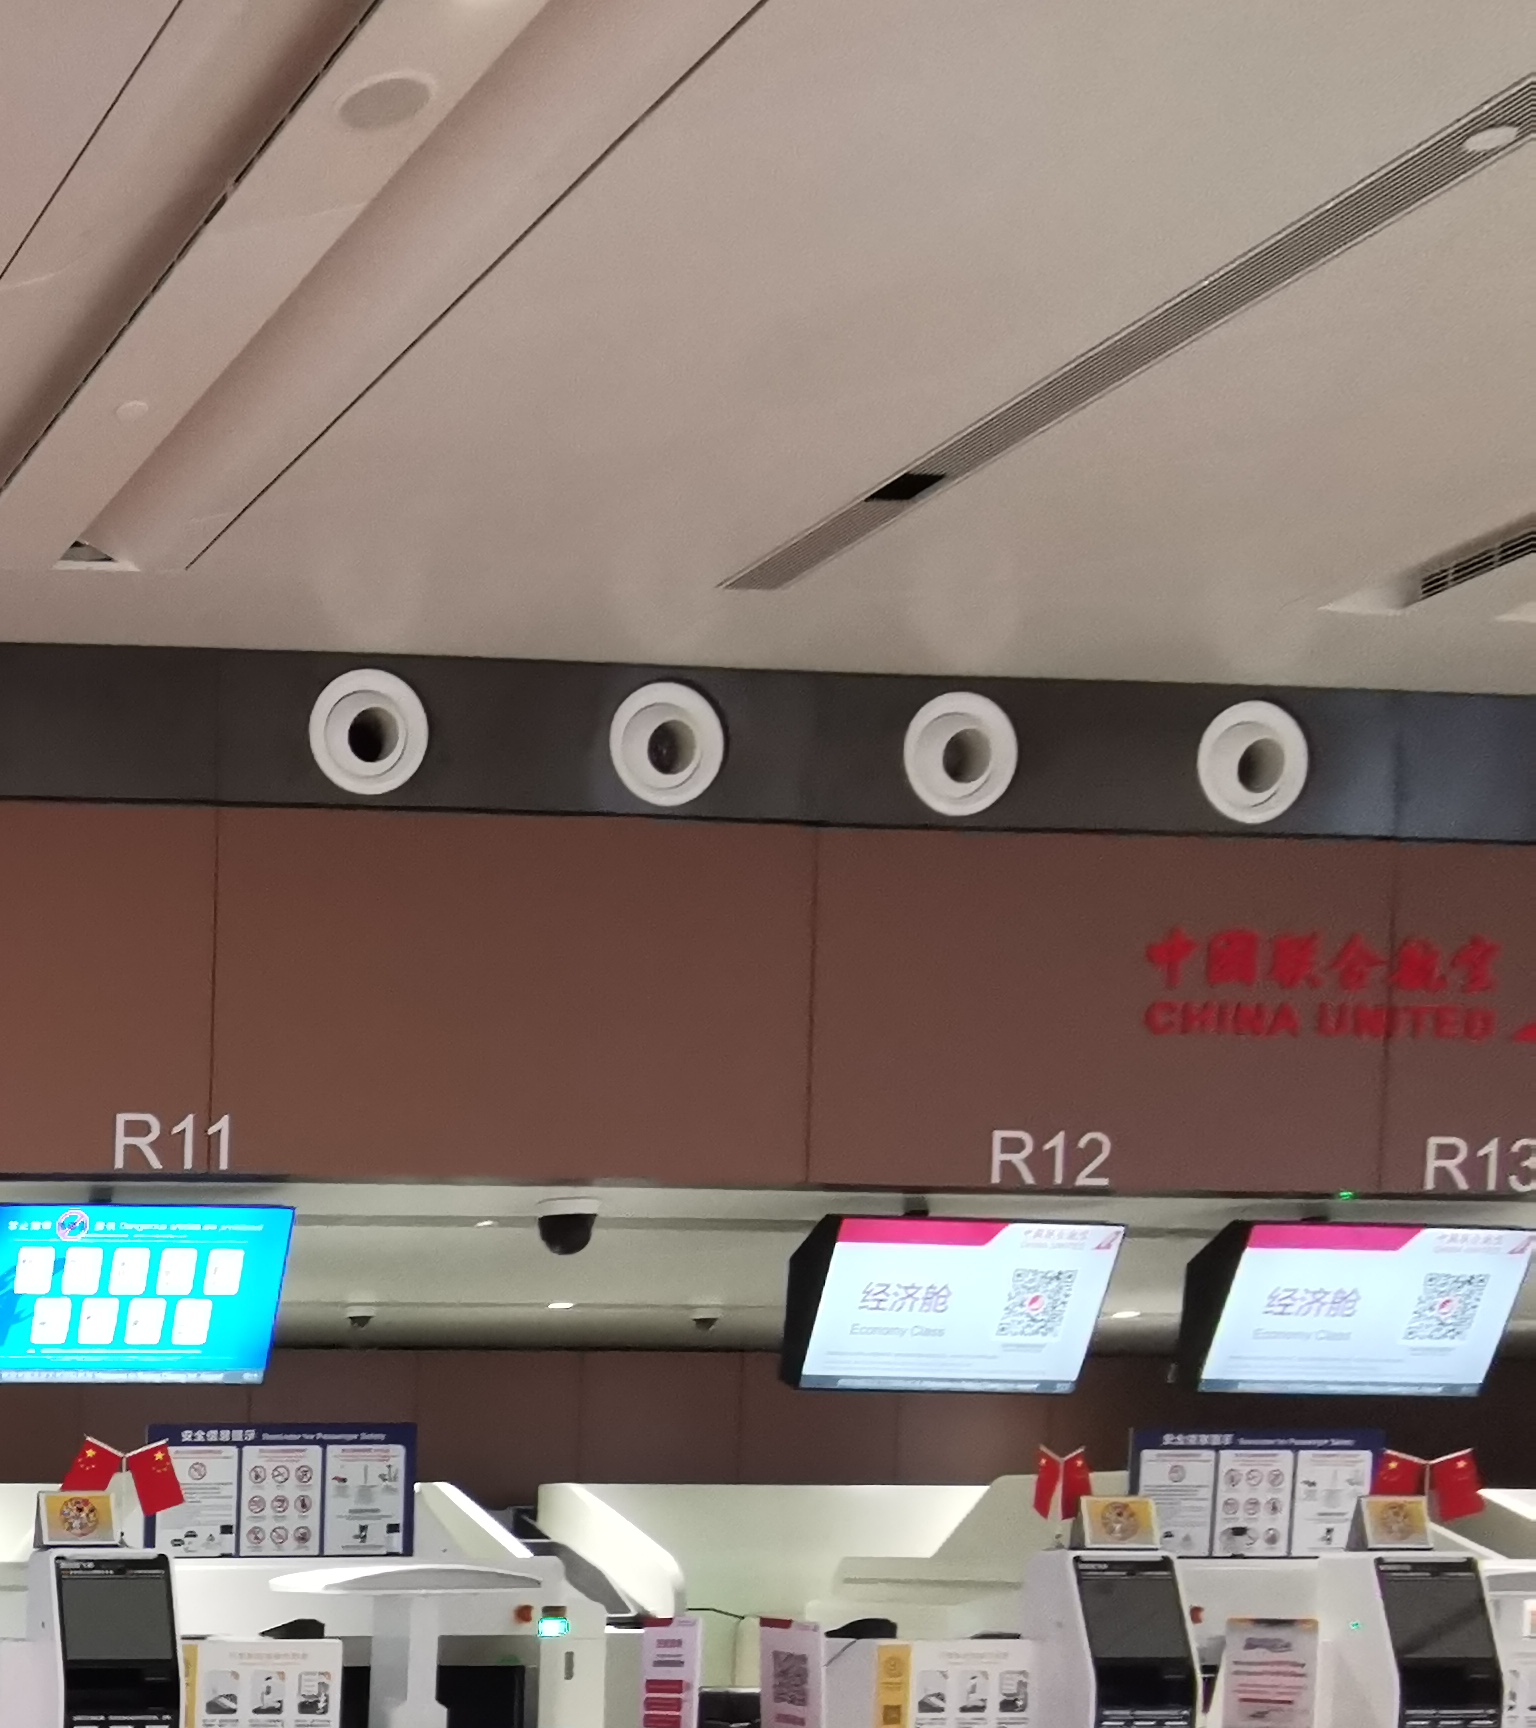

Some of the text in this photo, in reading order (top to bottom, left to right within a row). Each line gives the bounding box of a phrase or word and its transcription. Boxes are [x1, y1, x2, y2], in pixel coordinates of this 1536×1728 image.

[1143, 1000, 1498, 1041] CHINA UNITED
[114, 1112, 230, 1171] R11
[990, 1130, 1113, 1187] R12
[1423, 1136, 1536, 1191] R13
[858, 1281, 953, 1314] 经济舱
[1262, 1287, 1362, 1318] 经济舱
[849, 1323, 946, 1338] Economy Class
